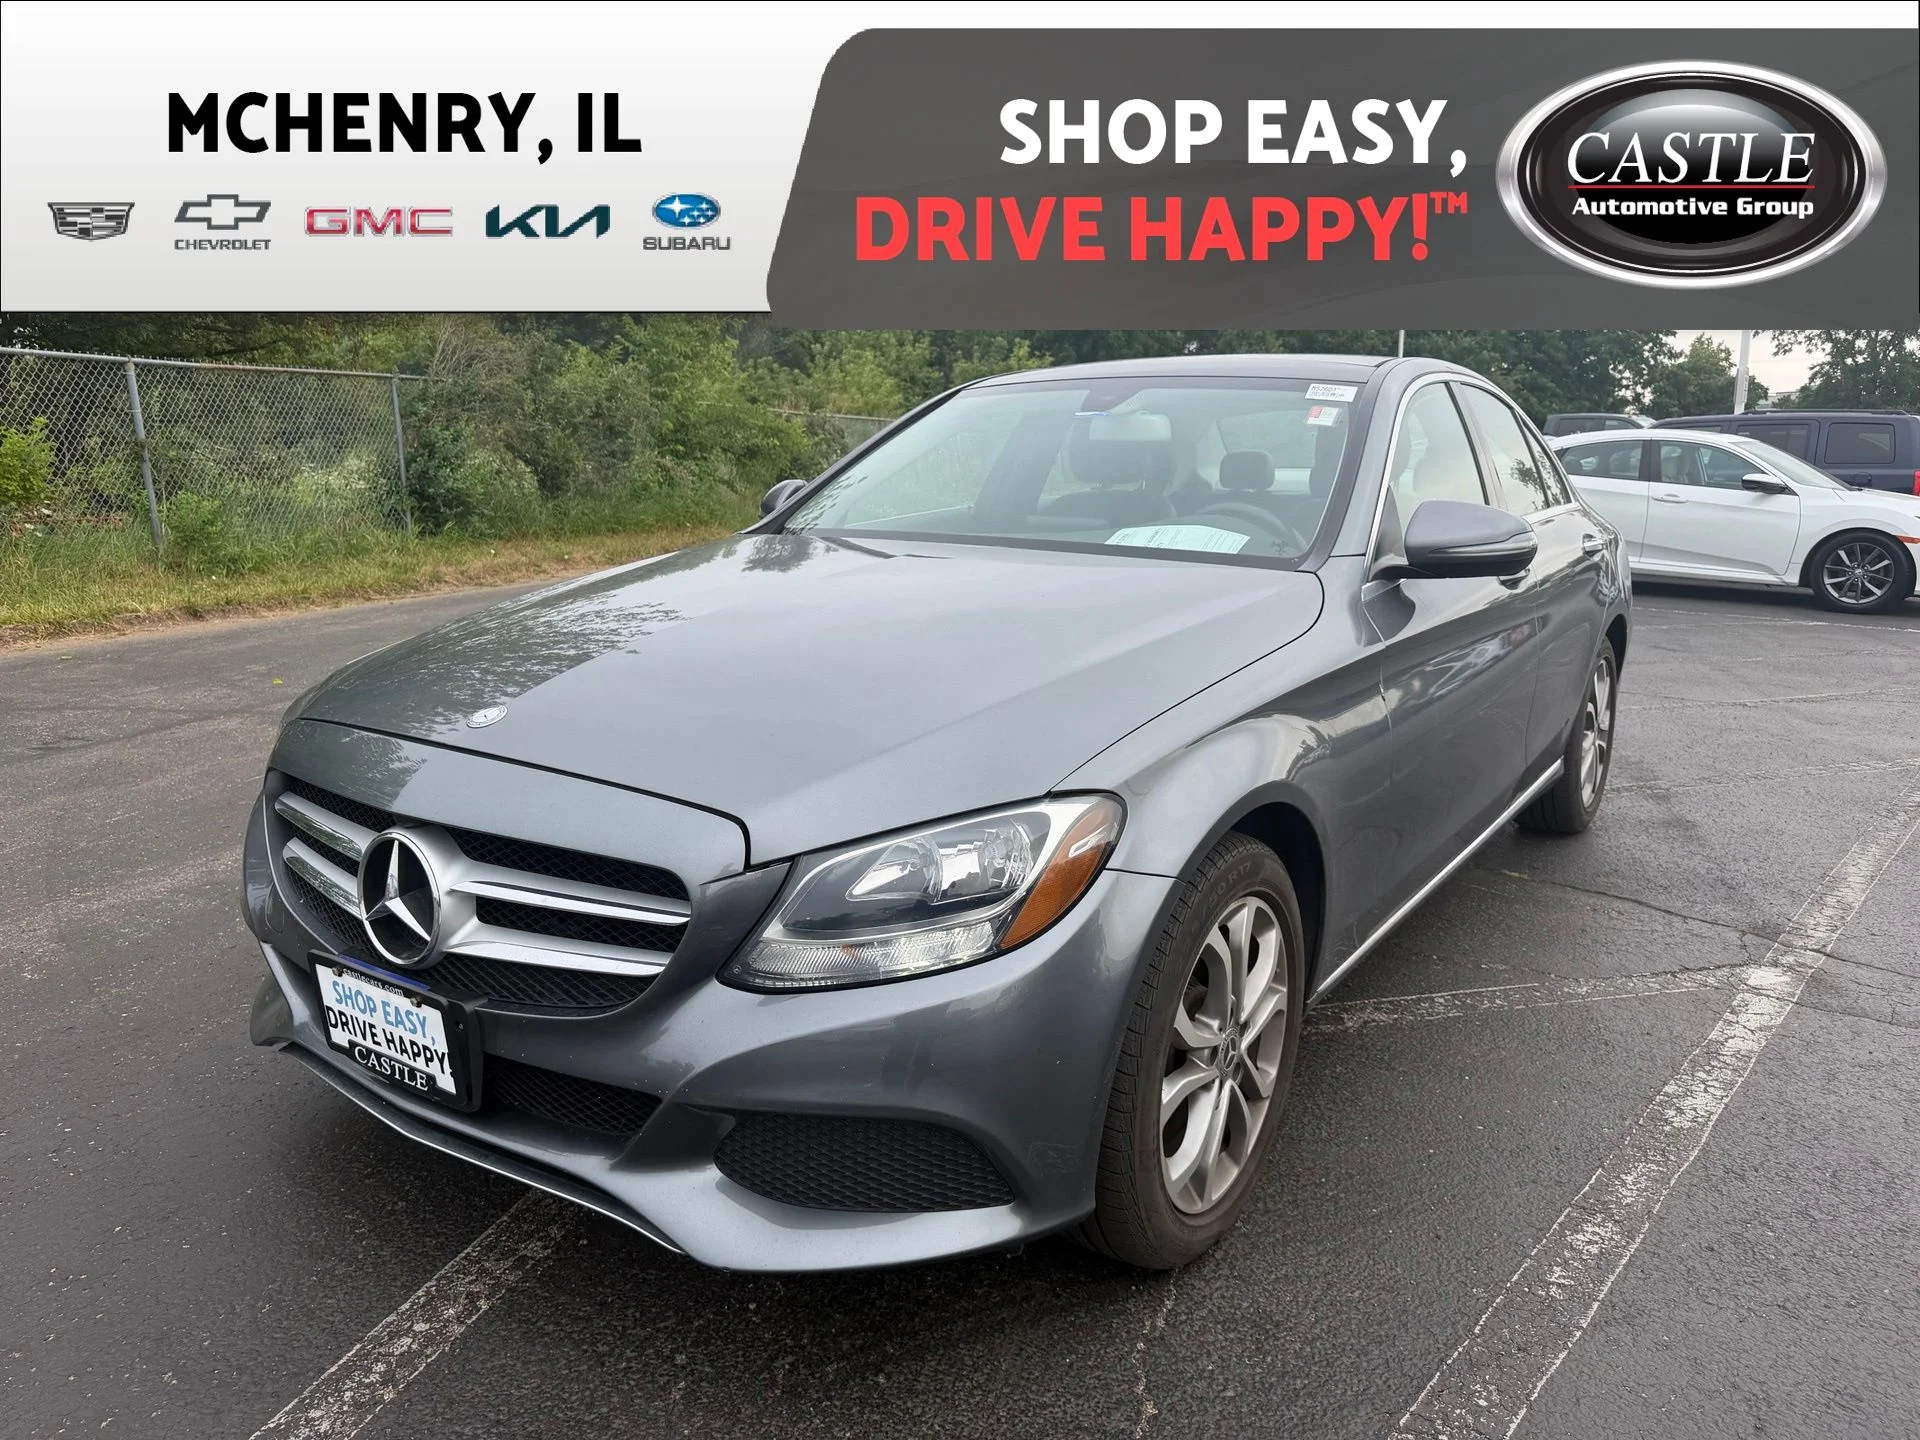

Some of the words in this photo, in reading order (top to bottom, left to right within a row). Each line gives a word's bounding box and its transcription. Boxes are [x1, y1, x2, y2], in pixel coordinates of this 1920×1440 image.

[332, 980, 377, 1018] SHOP
[325, 1005, 382, 1047] DRIVE
[354, 1046, 429, 1091] CASTLE
